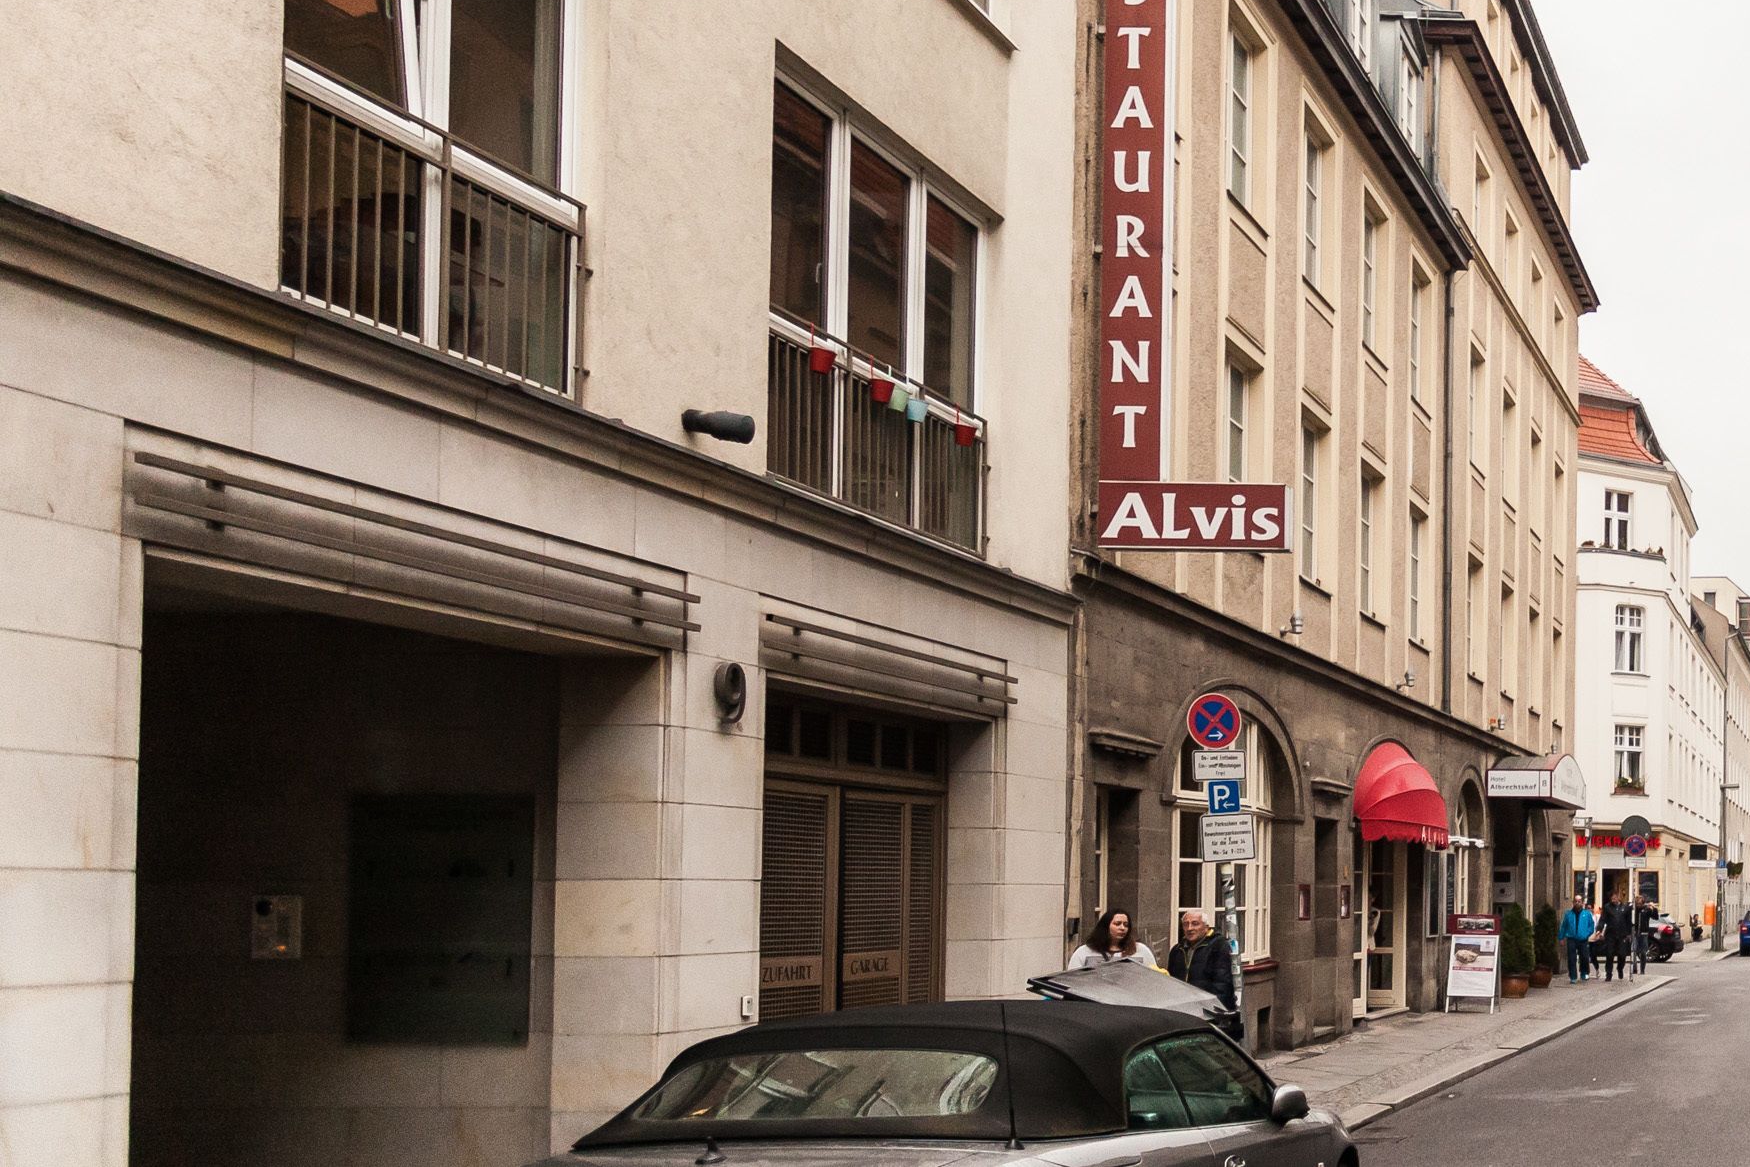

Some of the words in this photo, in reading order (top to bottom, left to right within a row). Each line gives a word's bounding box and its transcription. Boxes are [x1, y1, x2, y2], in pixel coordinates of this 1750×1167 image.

[713, 662, 746, 723] 9
[1213, 784, 1231, 810] P
[762, 965, 813, 983] ZUFAHRT
[850, 957, 889, 975] GARAGE
